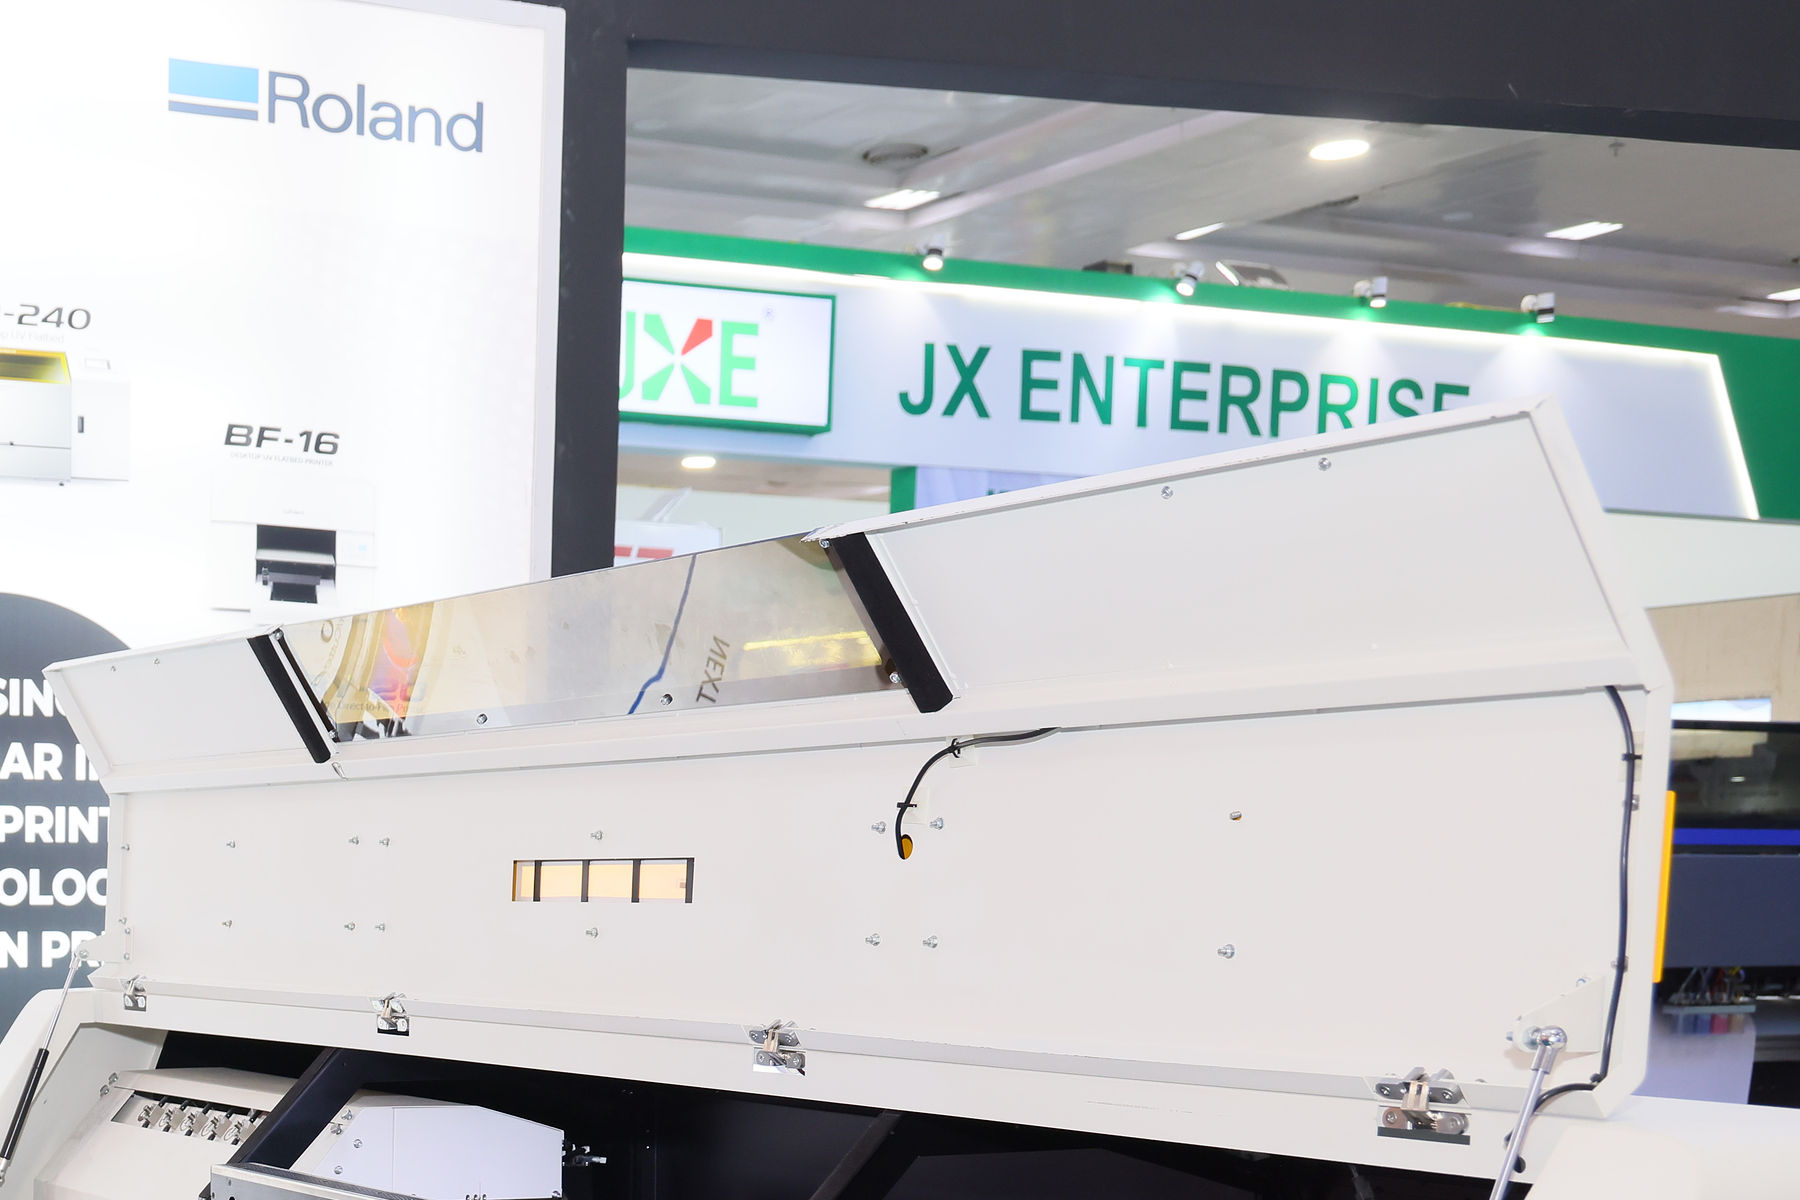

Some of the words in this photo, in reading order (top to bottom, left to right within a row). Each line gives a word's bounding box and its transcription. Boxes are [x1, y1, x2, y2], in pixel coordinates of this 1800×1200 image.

[267, 70, 484, 153] Roland
[898, 342, 991, 419] JX
[223, 423, 340, 455] BF-16
